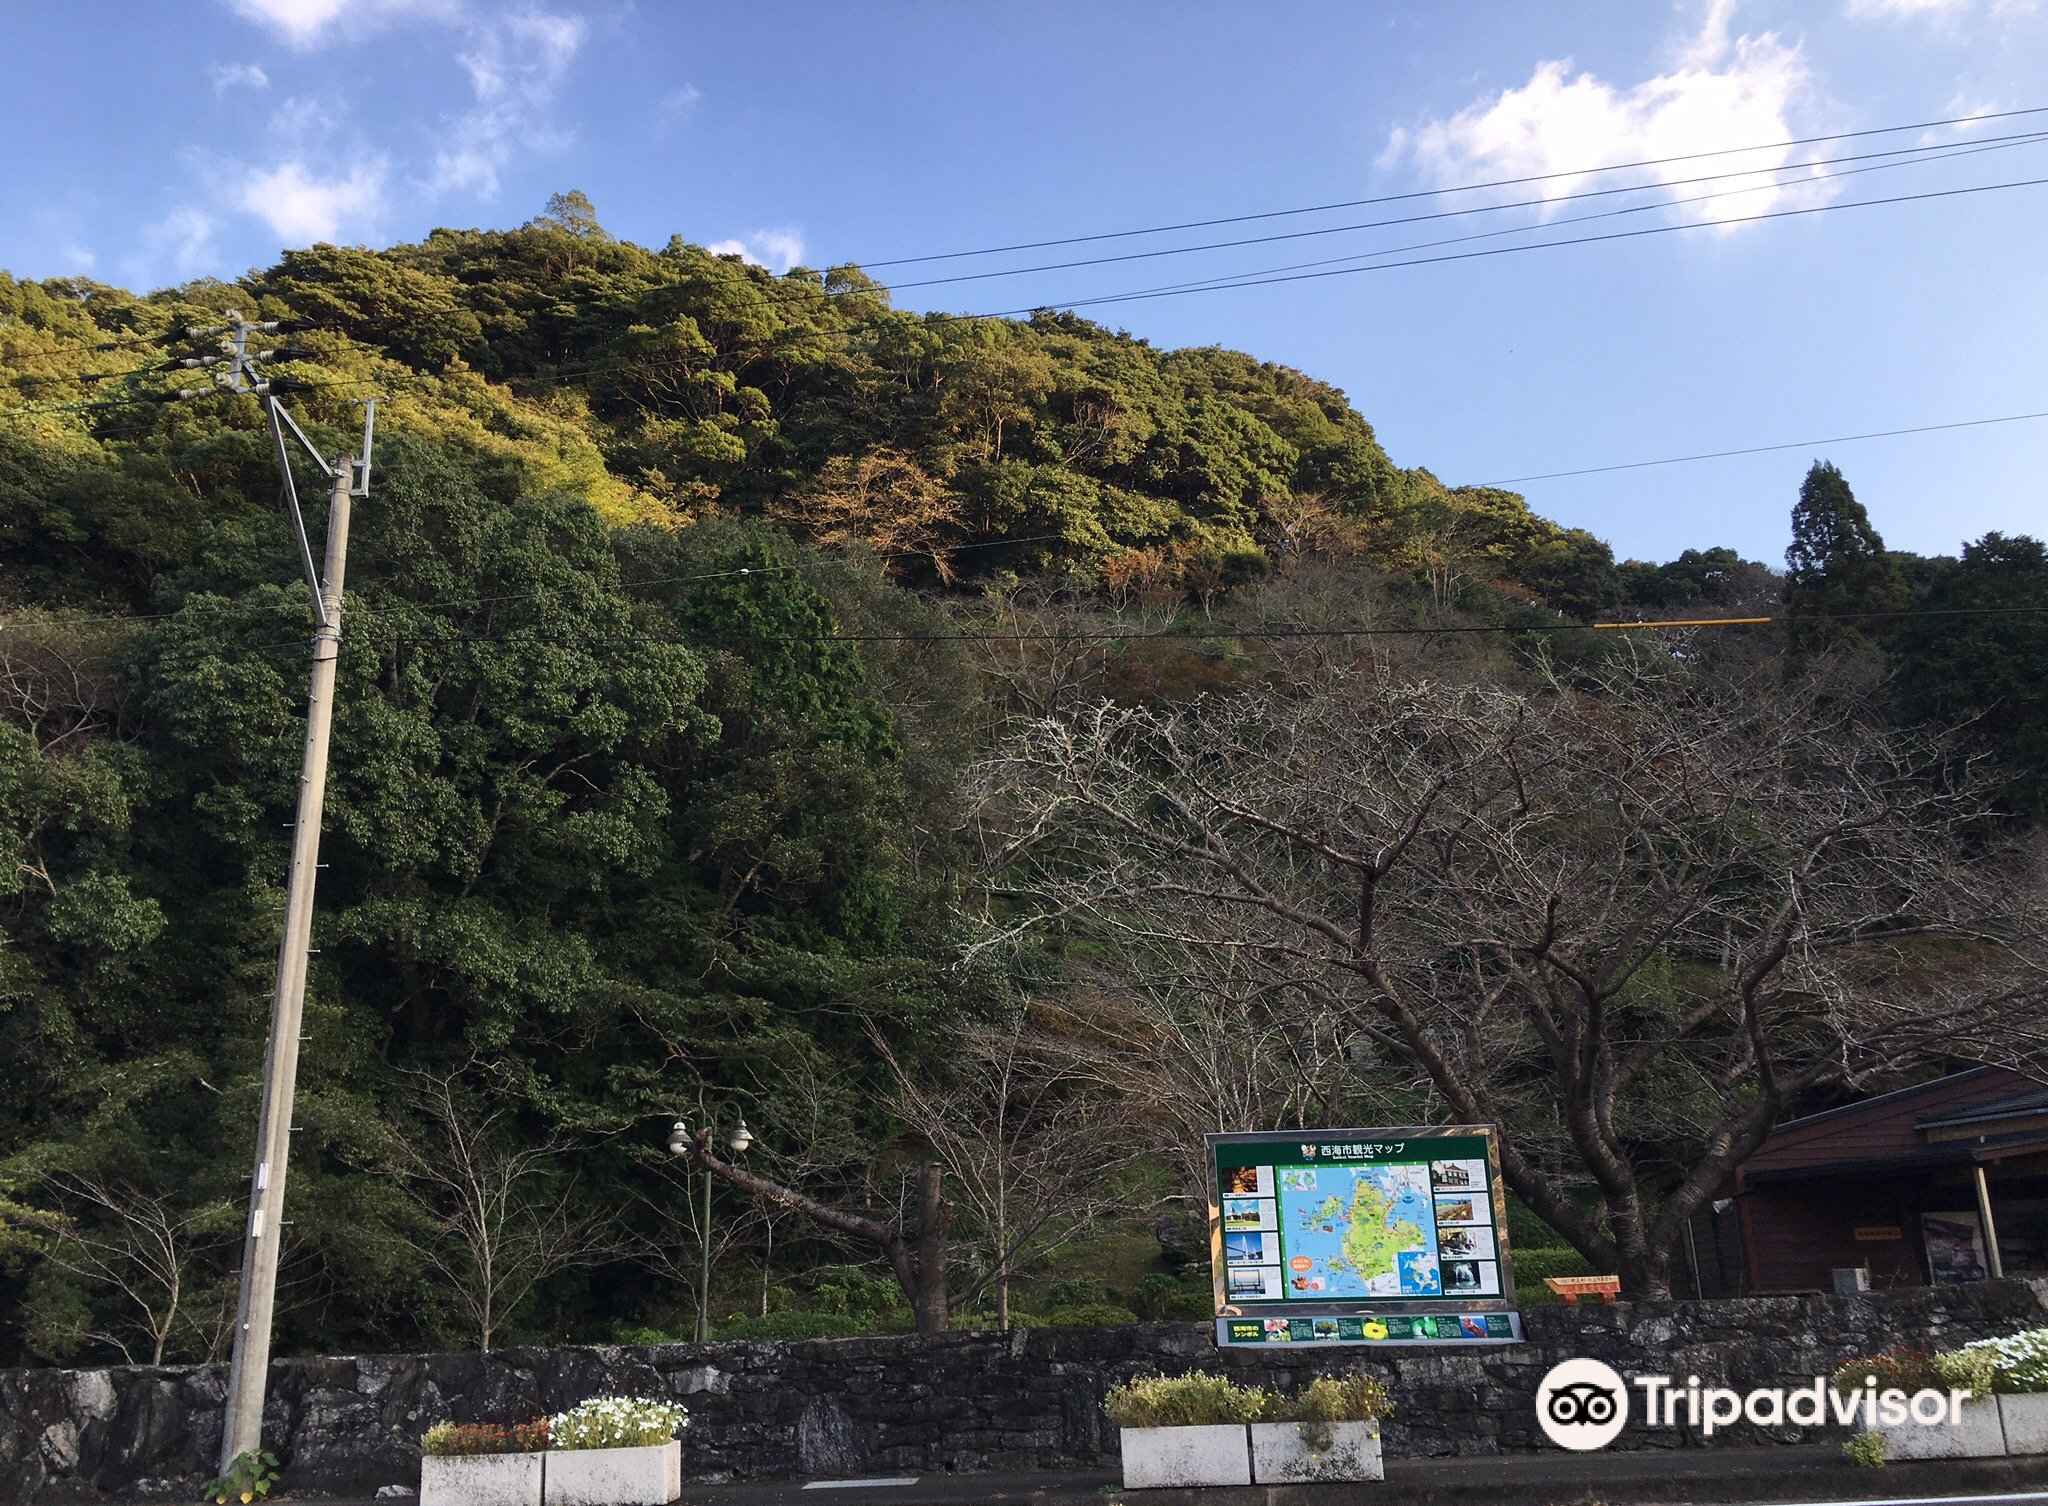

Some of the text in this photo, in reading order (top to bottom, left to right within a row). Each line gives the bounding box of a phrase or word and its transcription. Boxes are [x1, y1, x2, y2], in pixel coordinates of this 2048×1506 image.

[1320, 1142, 1405, 1156] 西海市観光マップ
